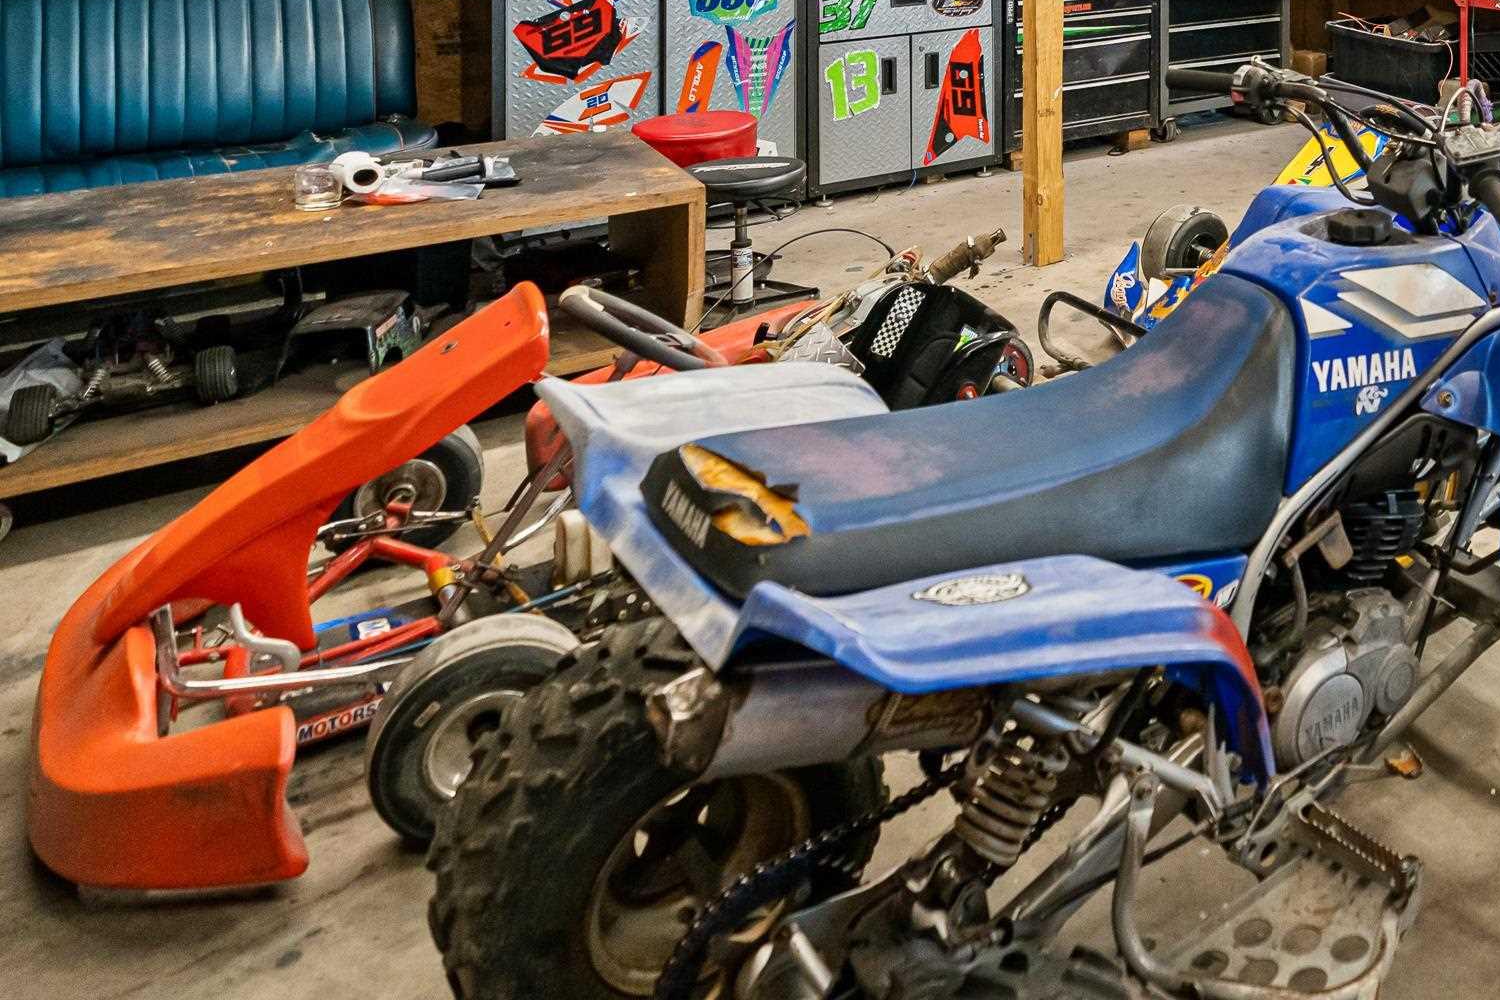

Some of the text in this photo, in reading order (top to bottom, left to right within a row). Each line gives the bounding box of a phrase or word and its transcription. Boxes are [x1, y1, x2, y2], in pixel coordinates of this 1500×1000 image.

[537, 8, 602, 57] 69
[586, 92, 608, 108] 20
[688, 62, 704, 101] APOLLO
[825, 49, 880, 120] 13
[1312, 348, 1417, 393] YAMAHA
[661, 478, 711, 549] YAMAHA
[1304, 696, 1359, 746] YAMAHA
